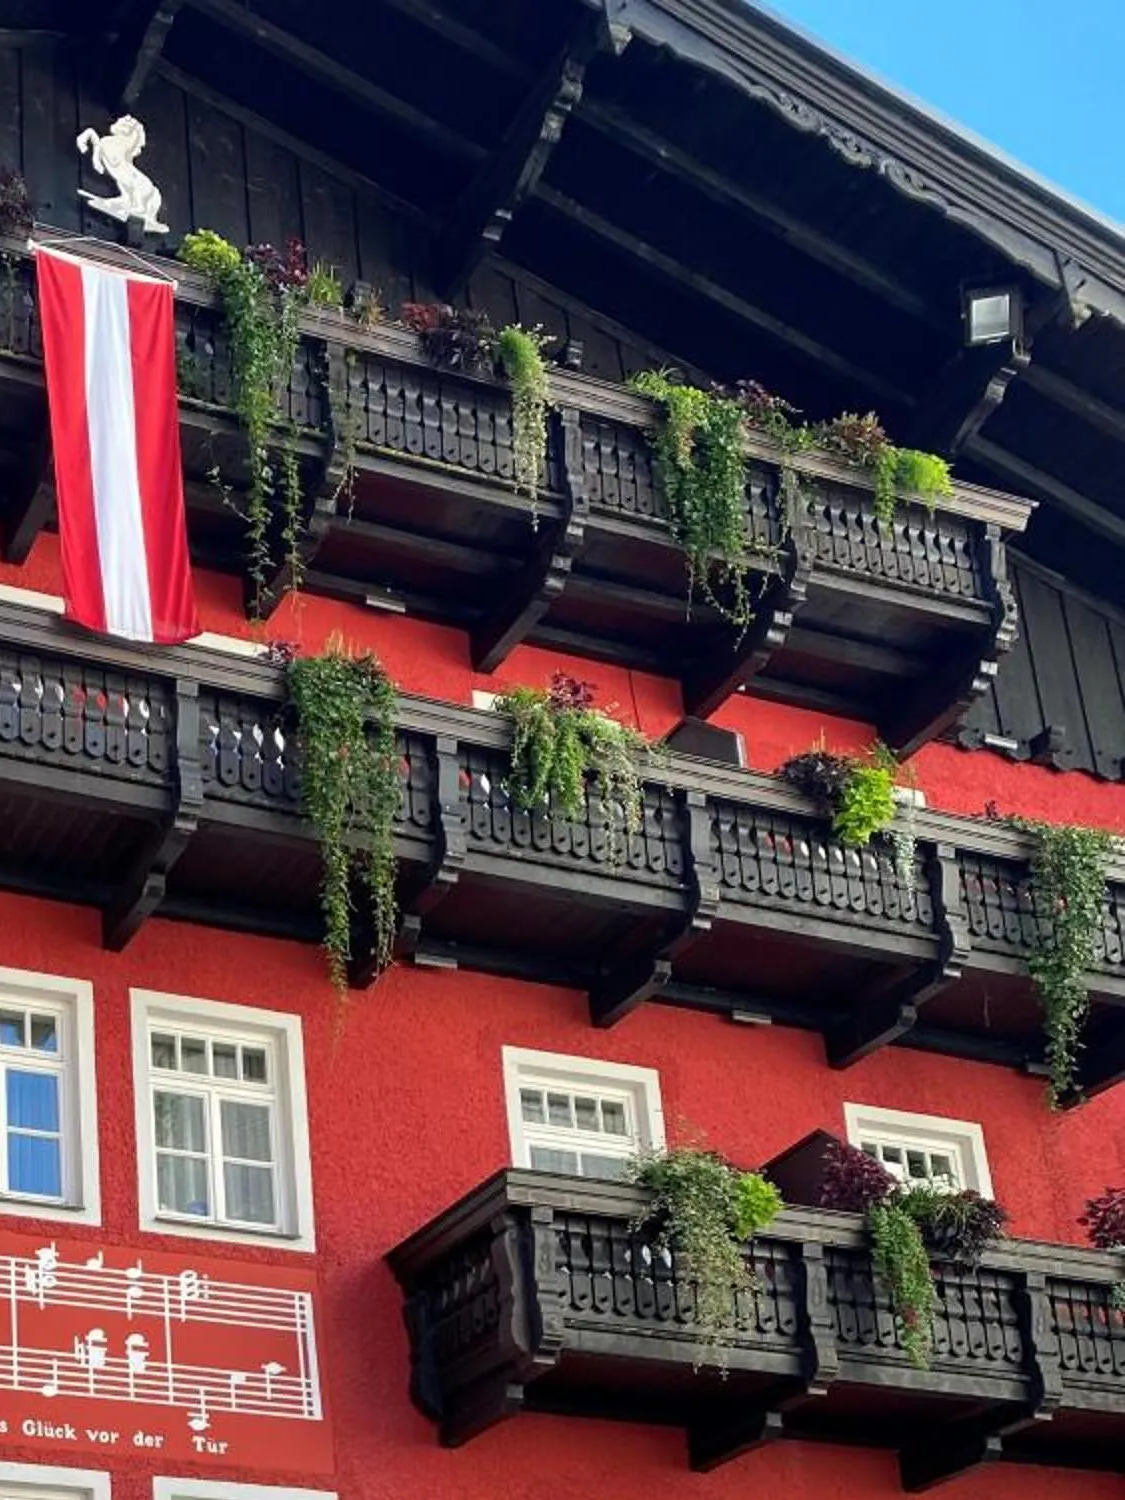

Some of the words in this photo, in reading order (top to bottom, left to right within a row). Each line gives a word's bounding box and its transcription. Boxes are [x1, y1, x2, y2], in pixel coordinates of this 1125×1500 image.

[21, 1418, 78, 1441] Glück
[85, 1429, 120, 1445] vor
[132, 1430, 164, 1449] der
